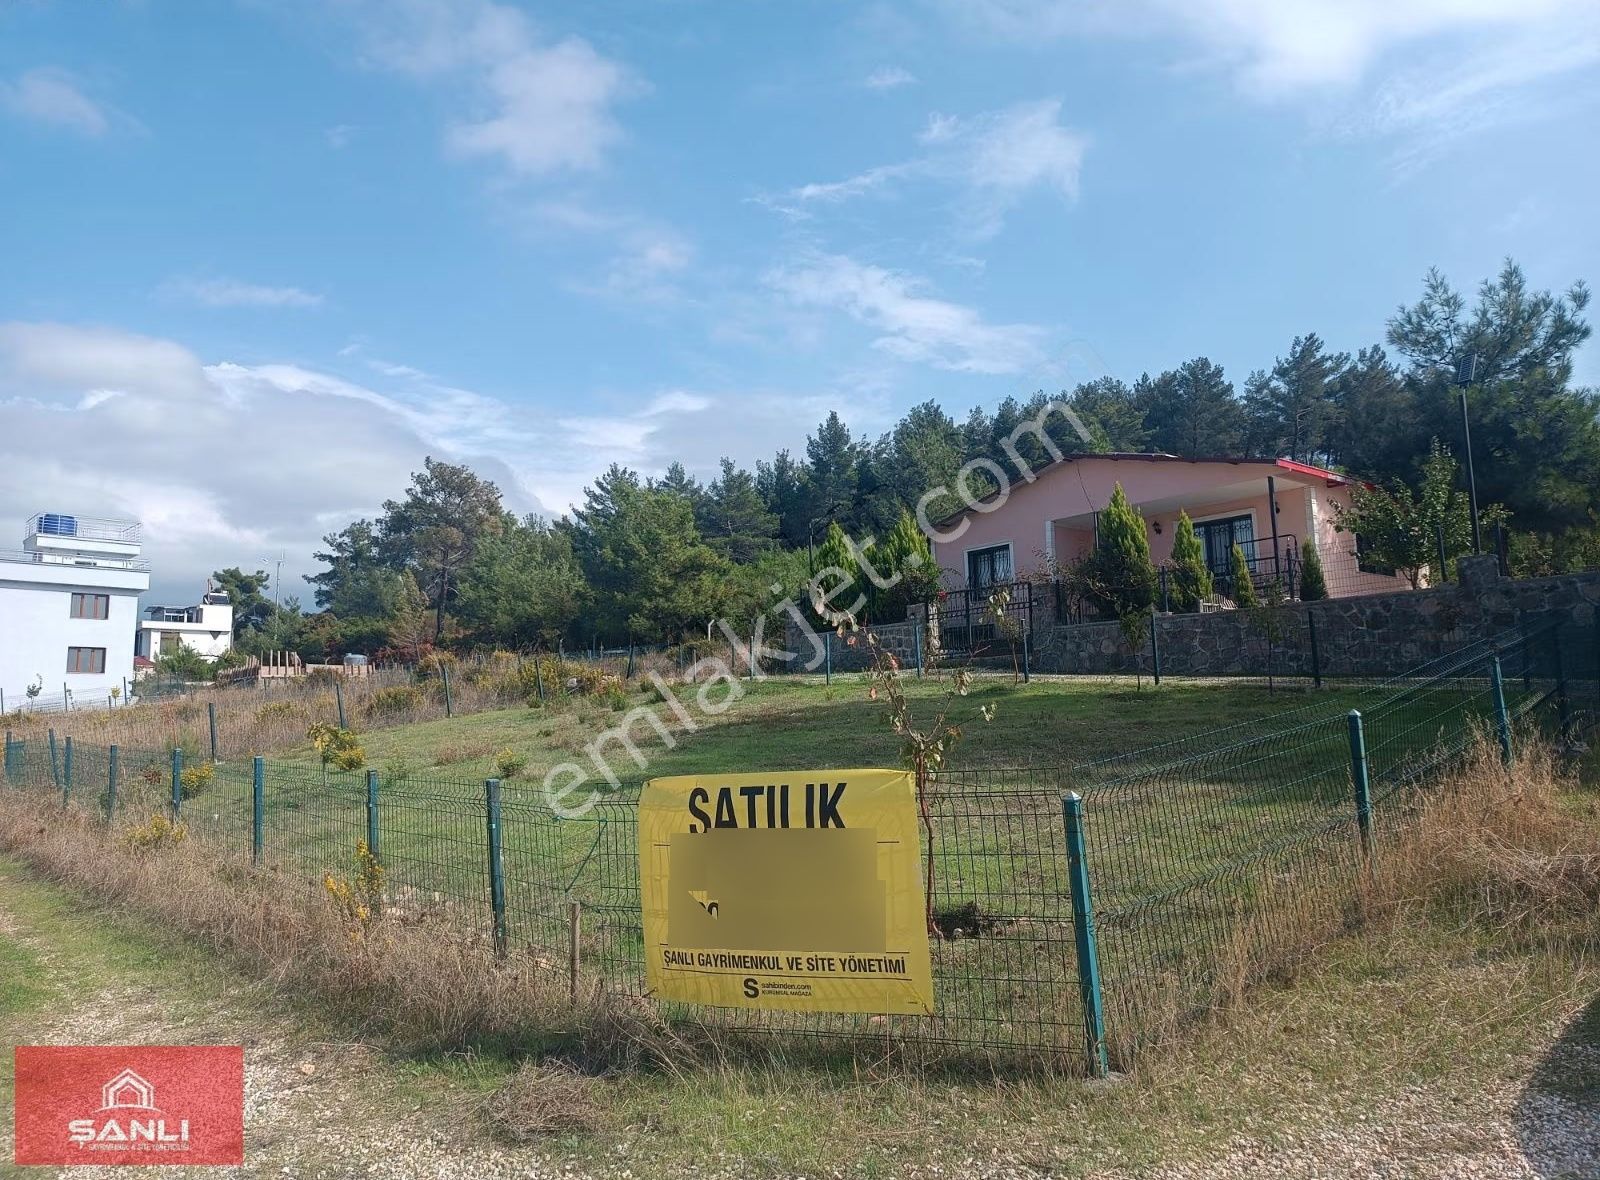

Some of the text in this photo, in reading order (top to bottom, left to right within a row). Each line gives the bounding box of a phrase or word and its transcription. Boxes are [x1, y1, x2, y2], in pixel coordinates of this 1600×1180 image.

[664, 950, 906, 974] ŞANLI GAYRİMENKUL VE SİTE YÖNETİMİ
[761, 981, 811, 990] sahibinden.com
